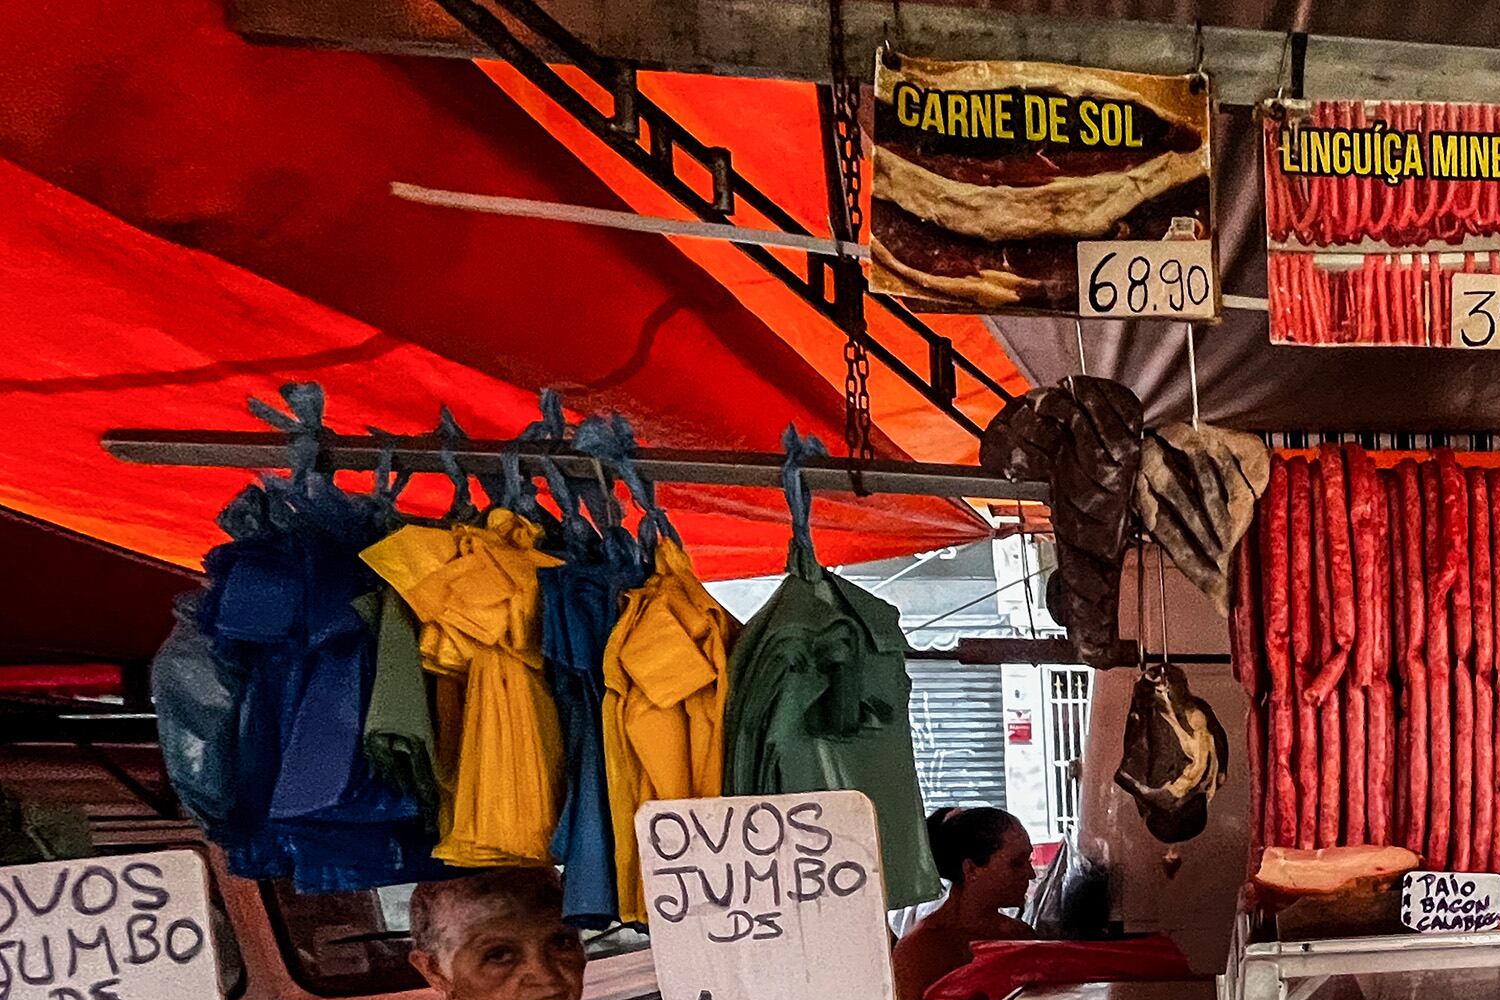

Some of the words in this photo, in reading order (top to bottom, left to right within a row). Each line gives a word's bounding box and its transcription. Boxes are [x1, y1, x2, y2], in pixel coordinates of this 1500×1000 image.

[898, 85, 1016, 140] CARNE
[1026, 95, 1071, 144] DE
[1077, 100, 1143, 148] SOL
[1283, 127, 1423, 183] LINGUÍÇA
[650, 802, 833, 860] OVOS
[653, 858, 866, 922] JUMBO
[1420, 895, 1490, 915] BACON
